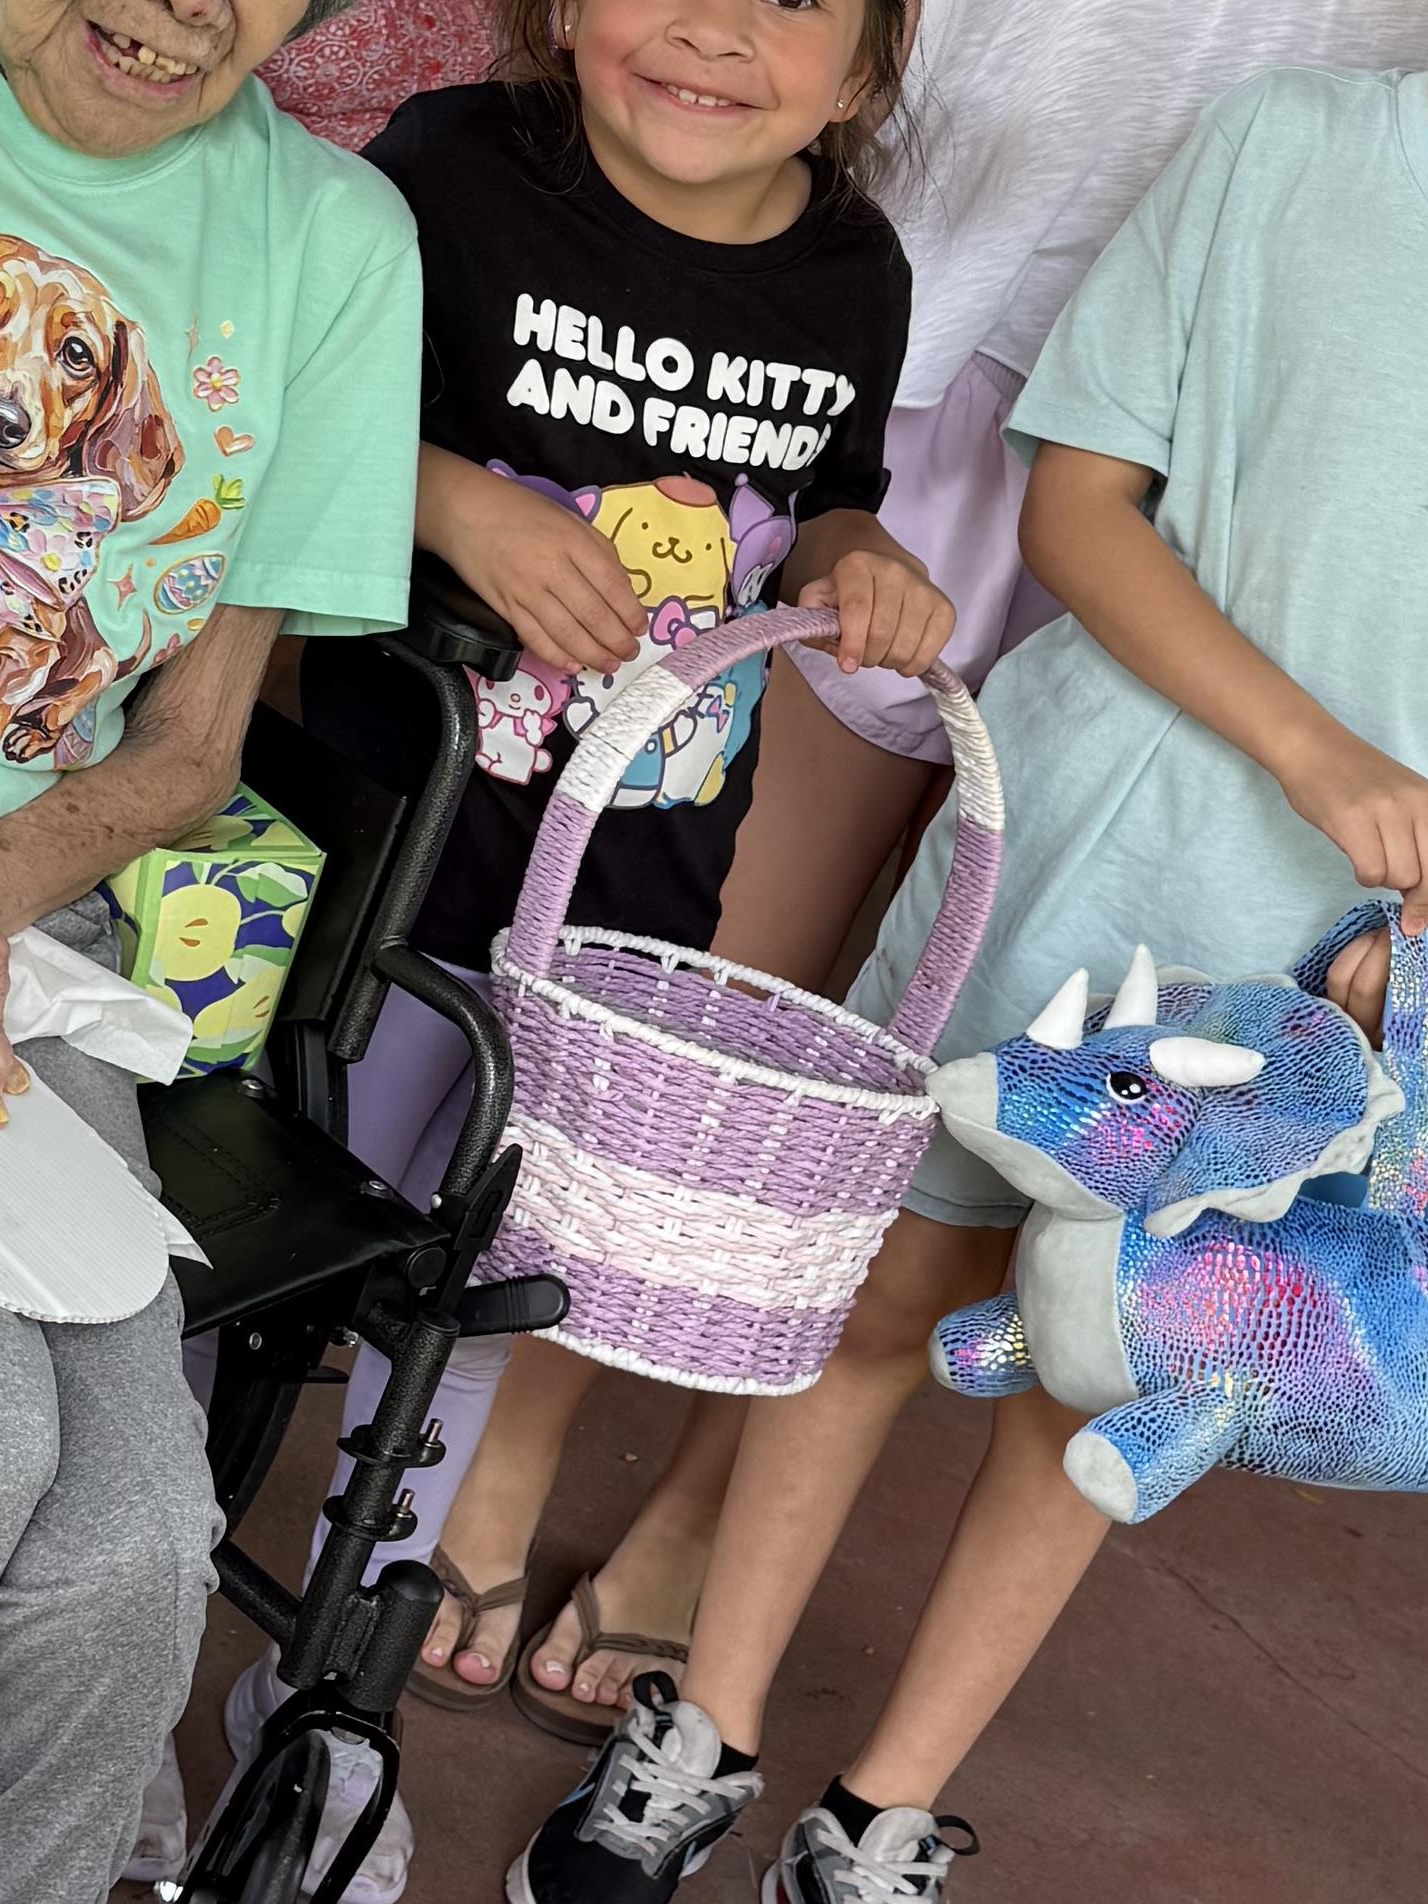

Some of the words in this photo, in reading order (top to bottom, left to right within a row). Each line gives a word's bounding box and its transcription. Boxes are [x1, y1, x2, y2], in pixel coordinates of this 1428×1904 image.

[506, 358, 635, 435] AND
[513, 293, 695, 391] HELLO
[706, 351, 857, 416] KITTY
